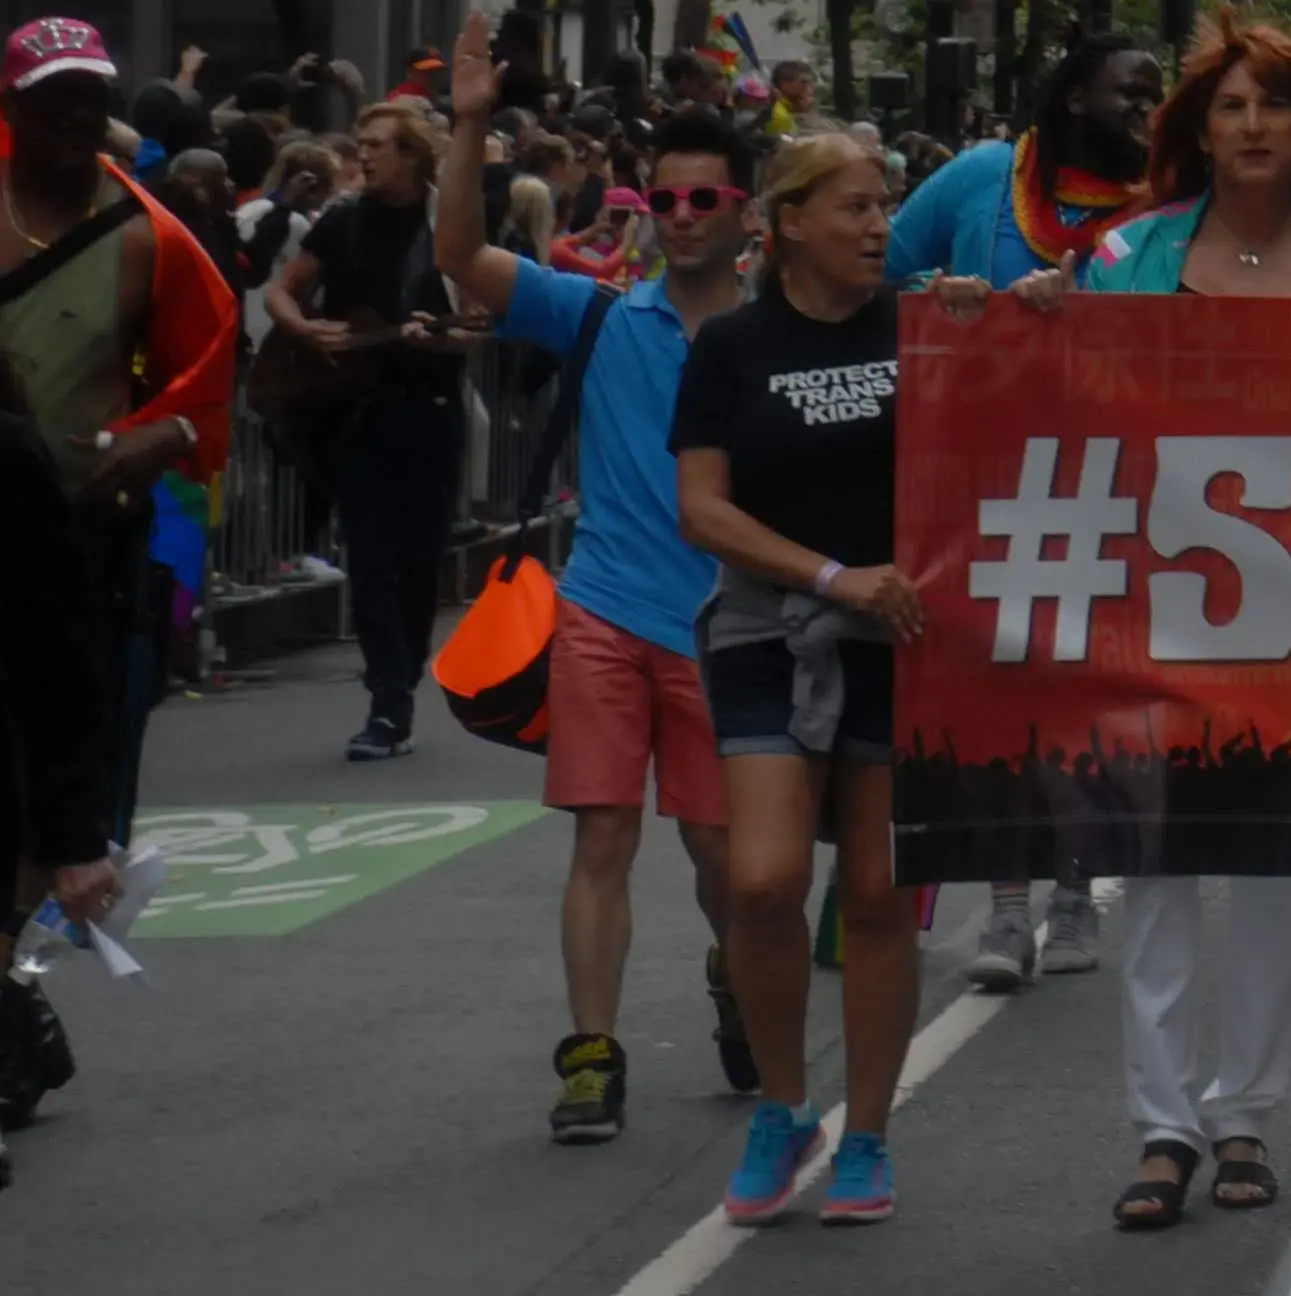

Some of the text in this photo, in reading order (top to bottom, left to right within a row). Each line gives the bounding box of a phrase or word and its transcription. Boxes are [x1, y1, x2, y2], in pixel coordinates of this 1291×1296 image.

[768, 359, 898, 394] PROTECT
[784, 377, 895, 409] TRANS
[803, 398, 882, 426] KIDS
